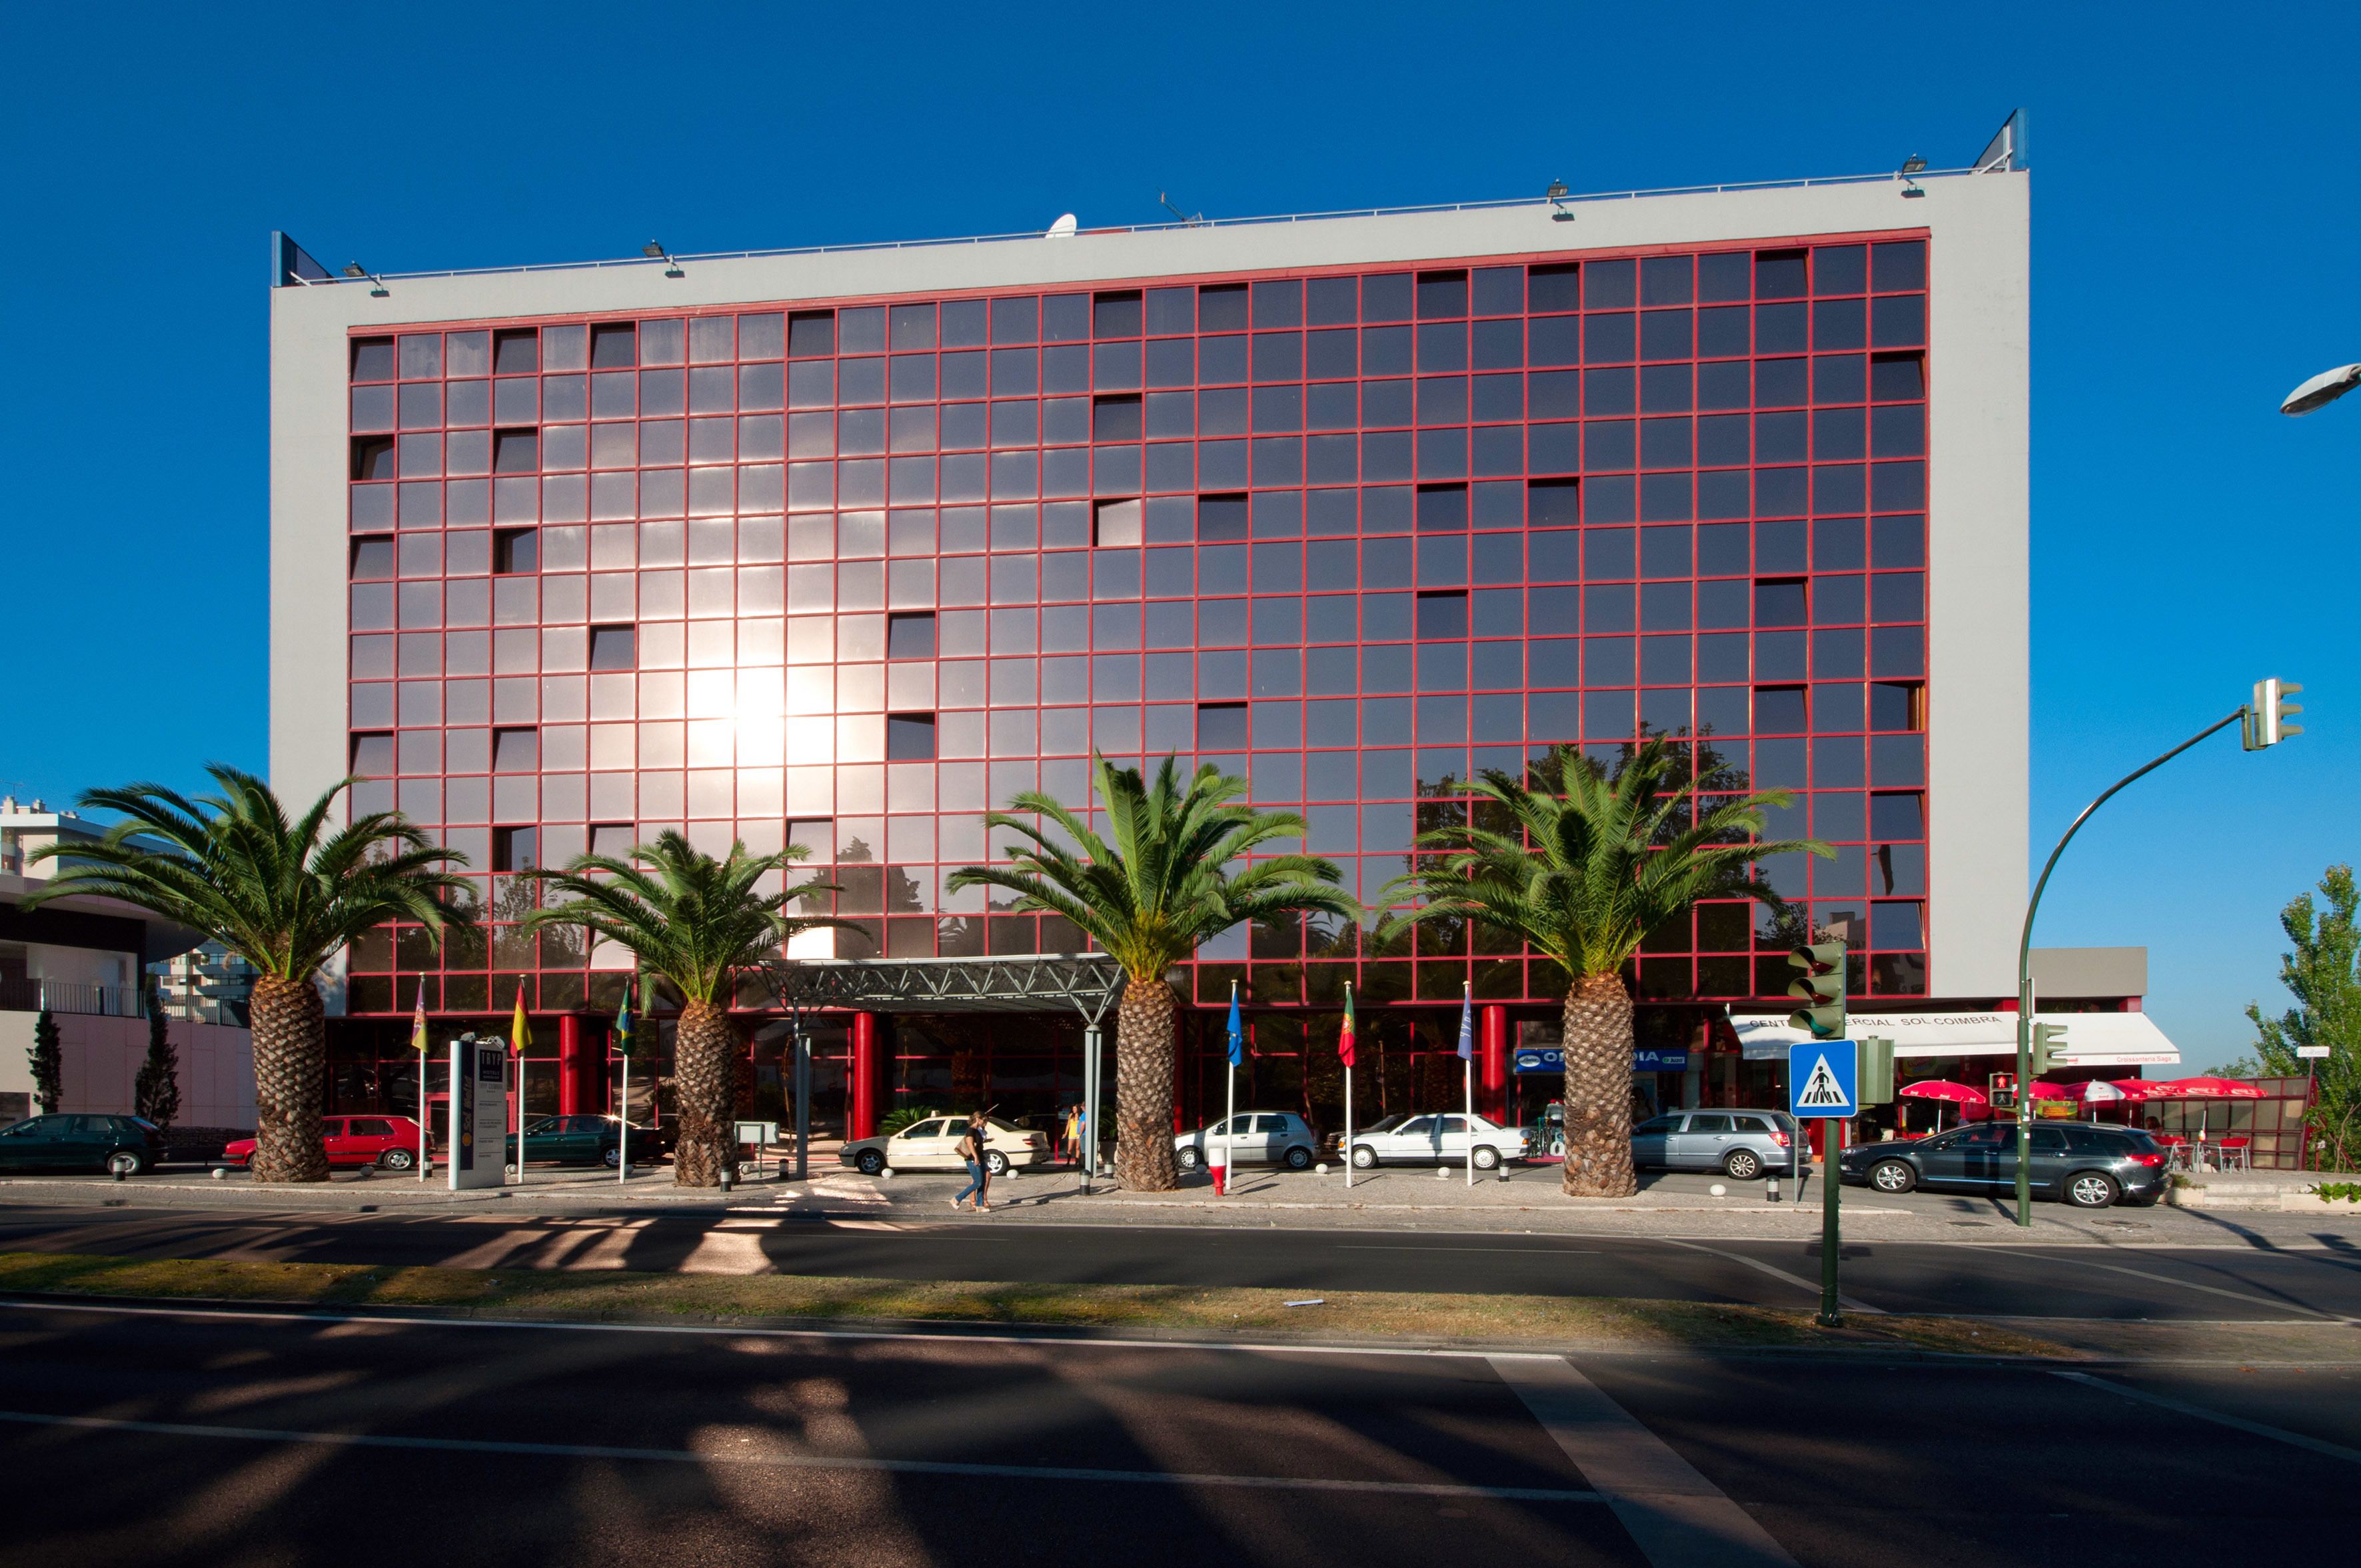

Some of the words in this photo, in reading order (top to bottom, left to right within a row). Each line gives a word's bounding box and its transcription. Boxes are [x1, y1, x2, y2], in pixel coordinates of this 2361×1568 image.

[1901, 1017, 1931, 1026] SOL
[1934, 1016, 2002, 1025] COIMBRA
[481, 1052, 501, 1065] TRYP
